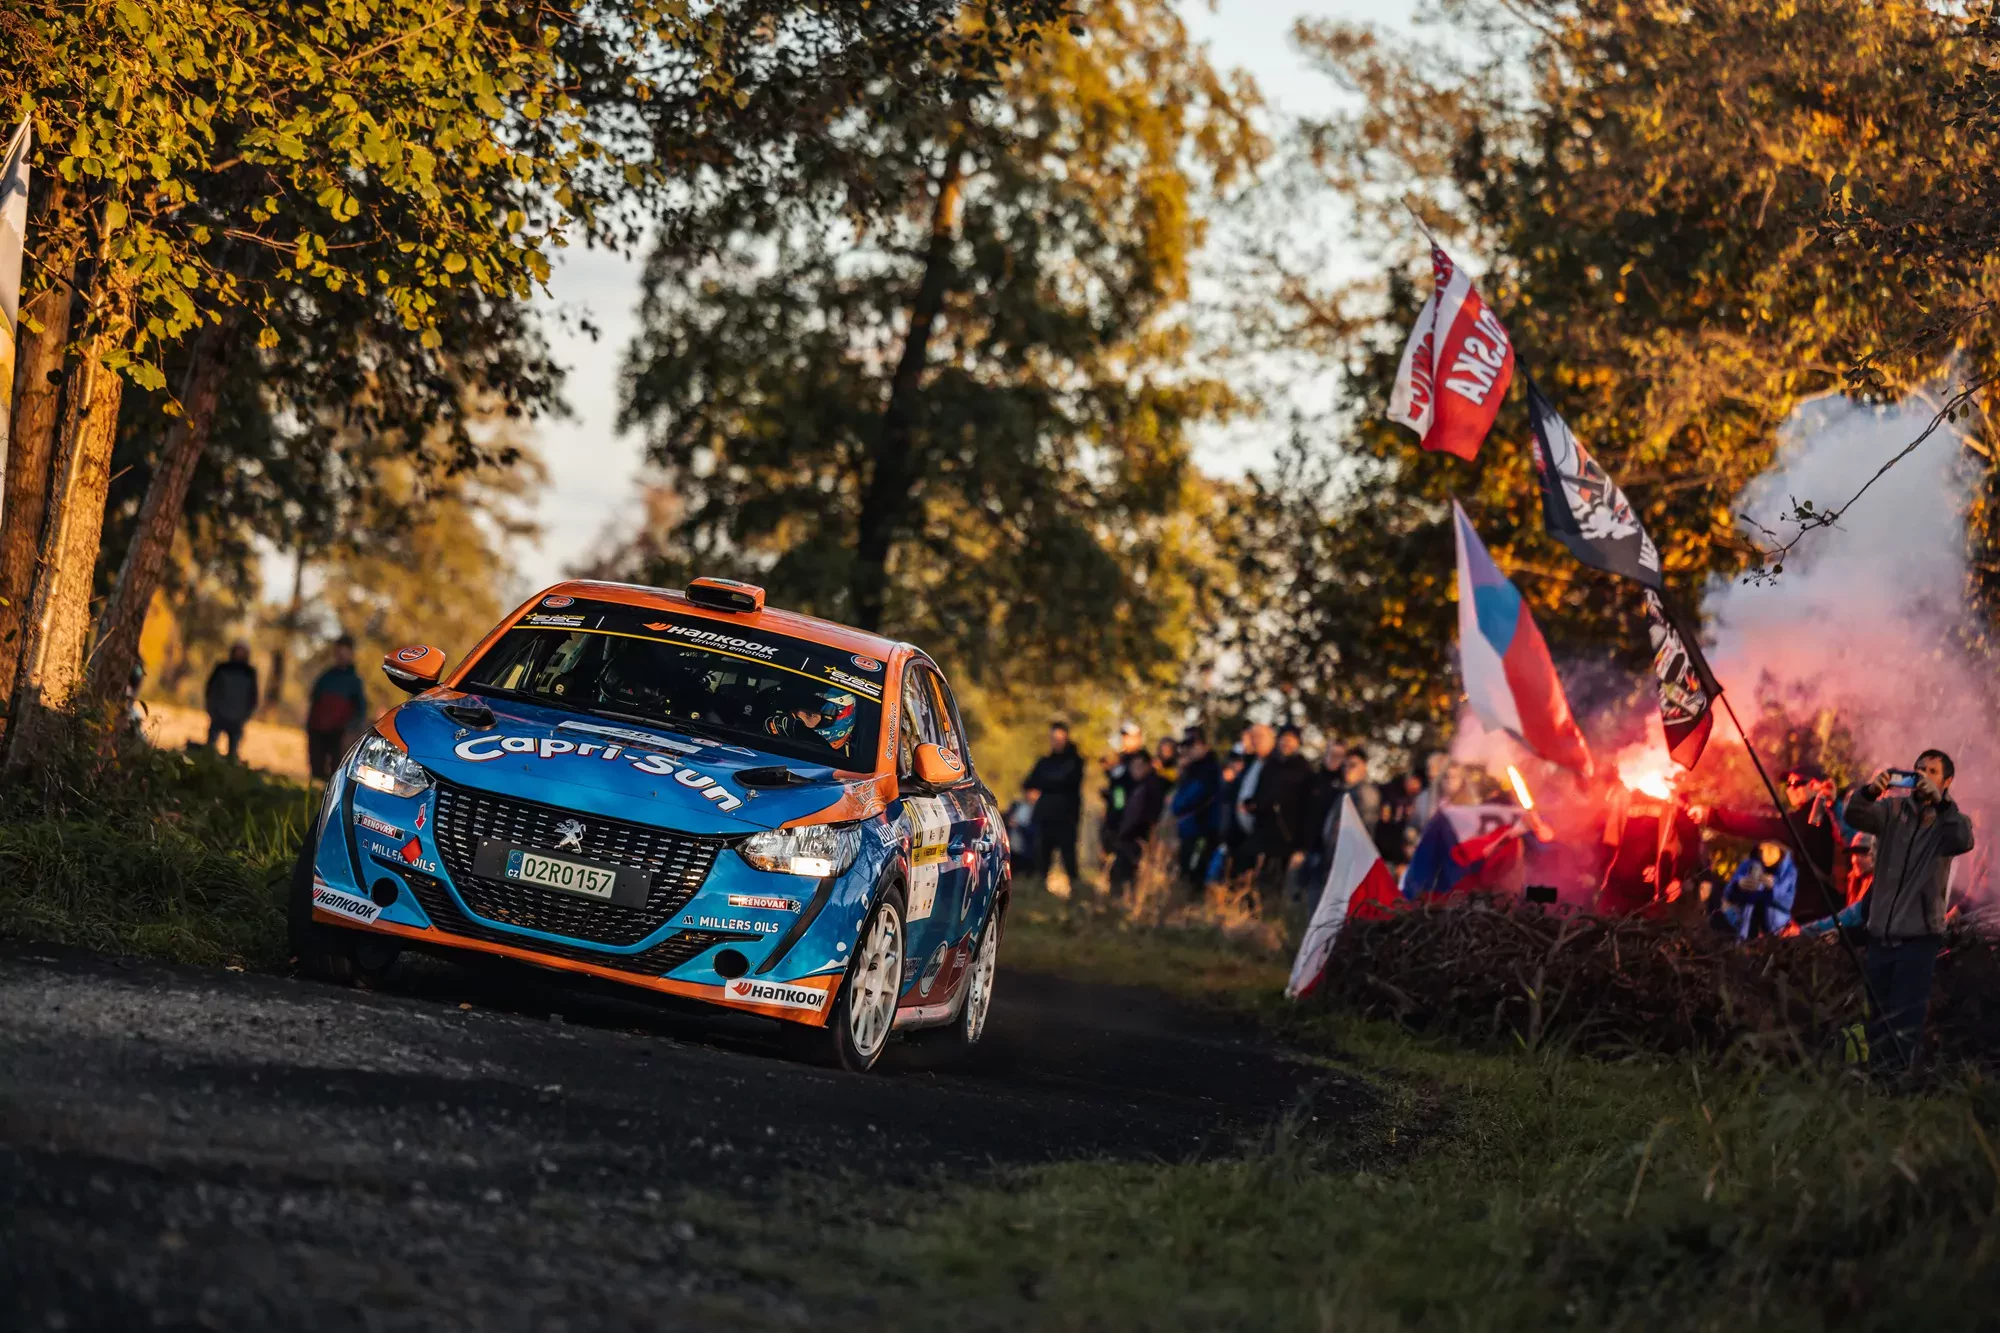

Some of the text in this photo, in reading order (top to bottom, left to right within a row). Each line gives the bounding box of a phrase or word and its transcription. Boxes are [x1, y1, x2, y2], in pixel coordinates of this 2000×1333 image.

[691, 638, 772, 660] driving emotion
[454, 735, 745, 813] Capri-Sun
[371, 842, 436, 872] MILLER OILS
[508, 869, 520, 878] CZ
[700, 916, 779, 933] MILLERS OILS
